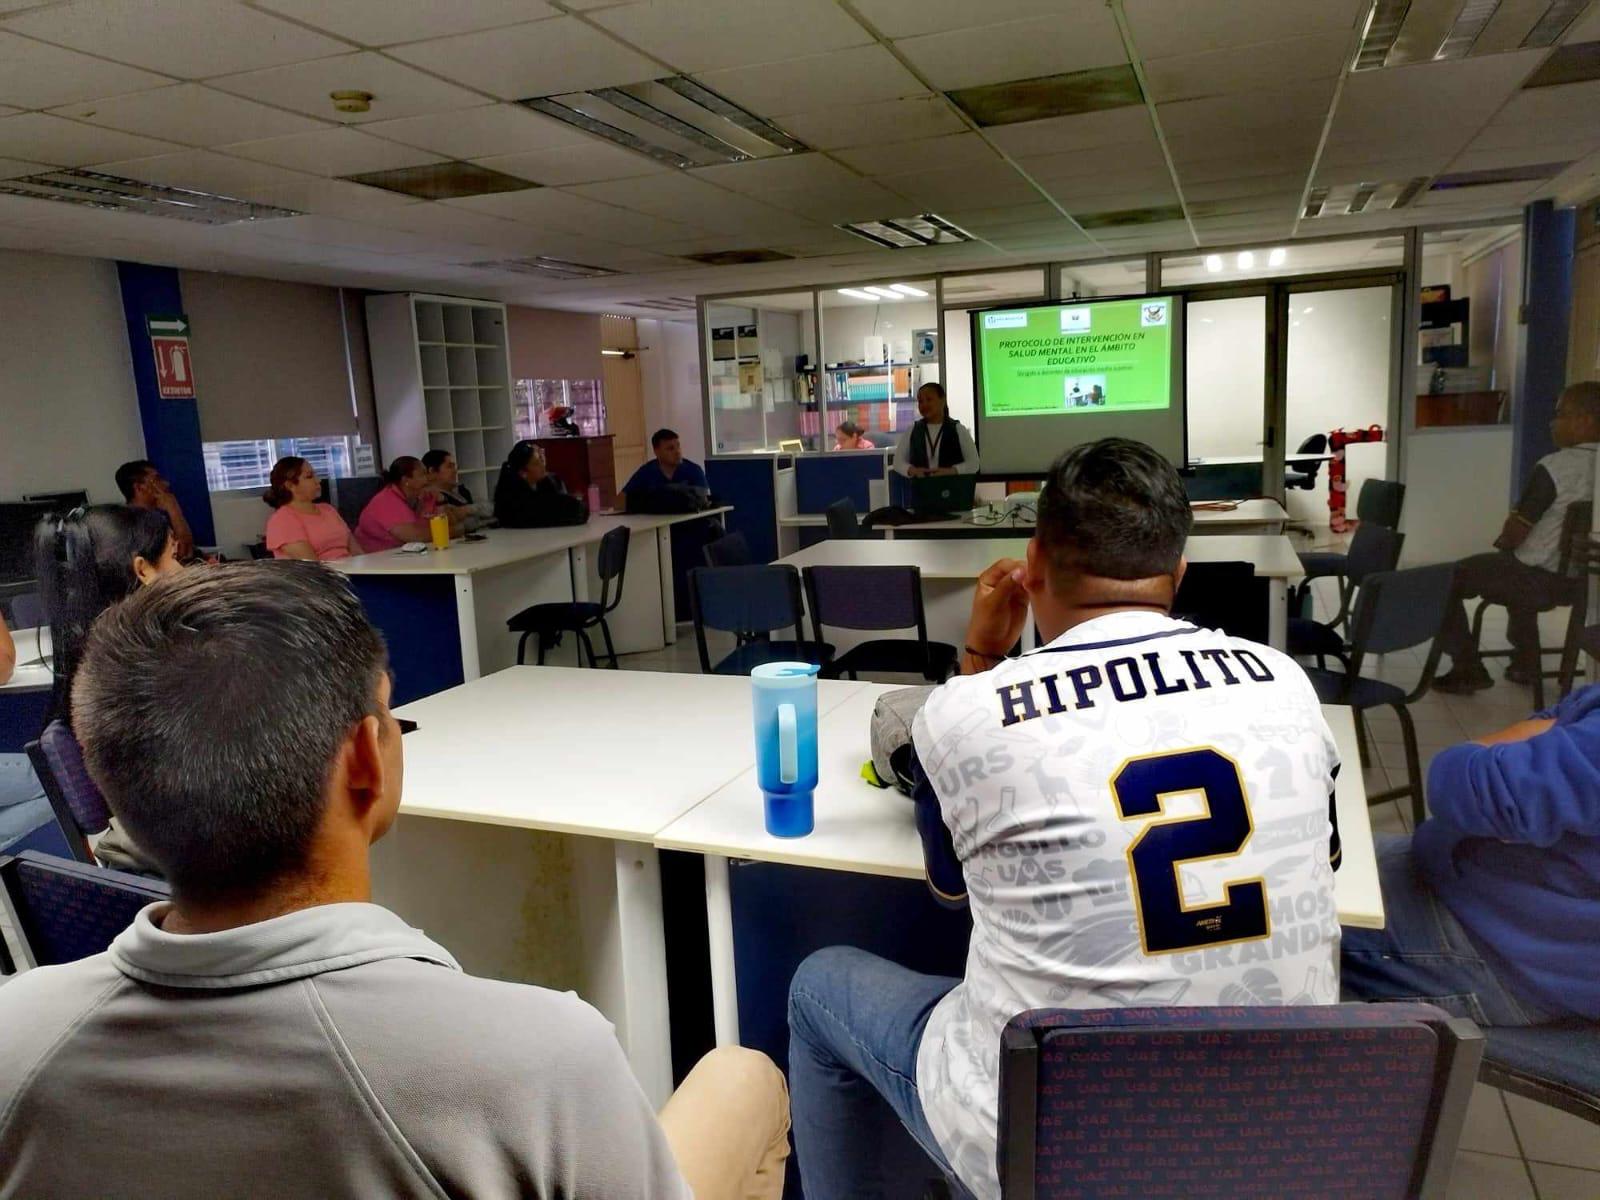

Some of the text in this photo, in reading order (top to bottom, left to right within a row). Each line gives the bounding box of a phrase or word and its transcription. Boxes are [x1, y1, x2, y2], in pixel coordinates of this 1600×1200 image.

[999, 337, 1051, 349] PROTOCOLO
[1053, 337, 1065, 346] DE
[1133, 333, 1145, 341] EN
[1008, 342, 1136, 358] SALUD MENTAL EN EL ÁMBITO
[1047, 355, 1096, 365] EDUCATIVO
[996, 649, 1275, 727] HIPOLITO
[1109, 745, 1271, 957] 2
[997, 856, 1066, 886] UAS
[1055, 1035, 1087, 1046] UAS
[1103, 1035, 1136, 1045] UAS
[1151, 1034, 1184, 1045] UAS
[1199, 1033, 1232, 1045] UAS
[1248, 1032, 1281, 1043] UAS
[1296, 1031, 1330, 1042] UAS
